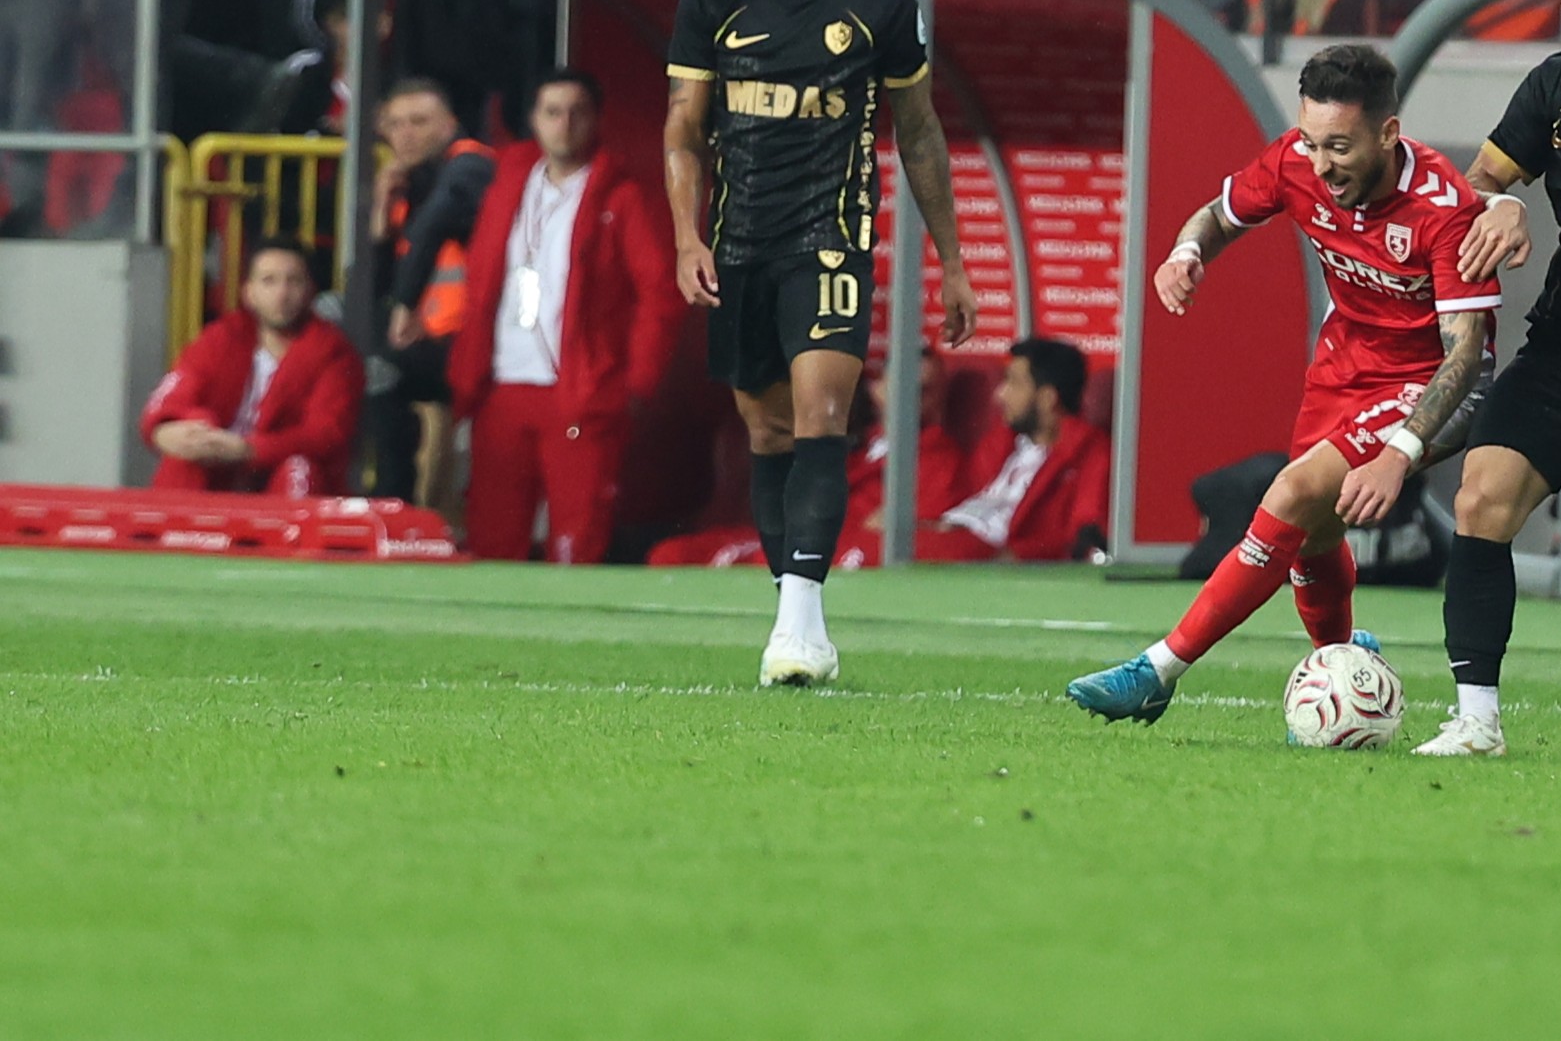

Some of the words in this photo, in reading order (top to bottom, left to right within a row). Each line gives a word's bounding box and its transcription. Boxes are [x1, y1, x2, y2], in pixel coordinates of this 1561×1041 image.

[1310, 236, 1432, 293] OREX
[817, 272, 858, 317] 10
[1352, 666, 1372, 687] 55
